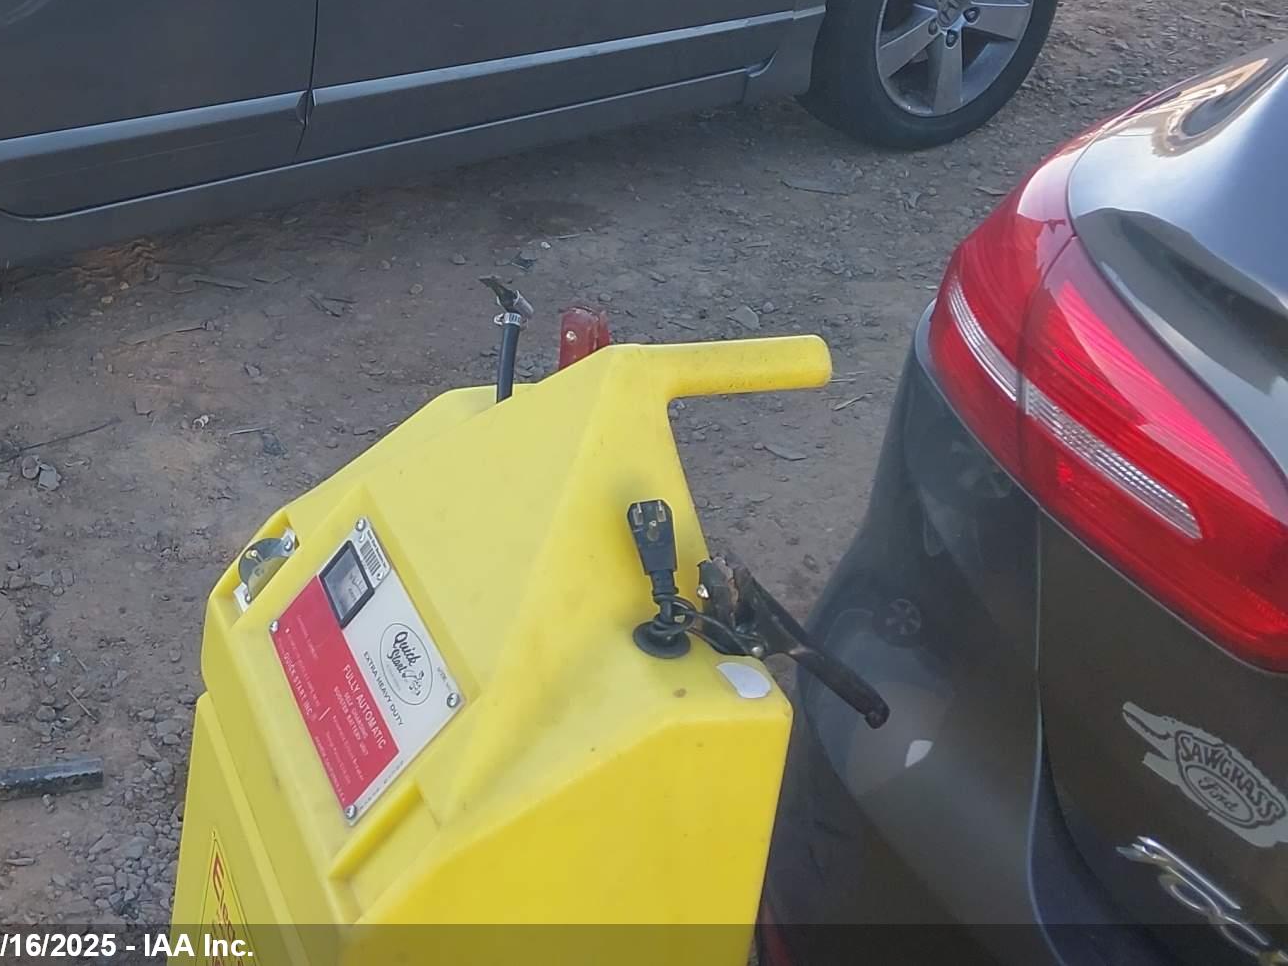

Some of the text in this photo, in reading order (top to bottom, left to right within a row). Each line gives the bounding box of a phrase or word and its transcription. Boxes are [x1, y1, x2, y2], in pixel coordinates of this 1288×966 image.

[386, 649, 407, 674] Start
[393, 631, 422, 667] Quick
[283, 651, 296, 676] QUICK
[293, 675, 306, 701] START
[363, 650, 378, 677] EXTRA
[376, 676, 392, 703] HEAVY
[390, 703, 404, 726] DUTY
[342, 664, 360, 695] FULLY
[355, 691, 387, 750] AUTOMATIC
[1180, 735, 1278, 819] SAWGRASS
[1198, 776, 1240, 813] Ford
